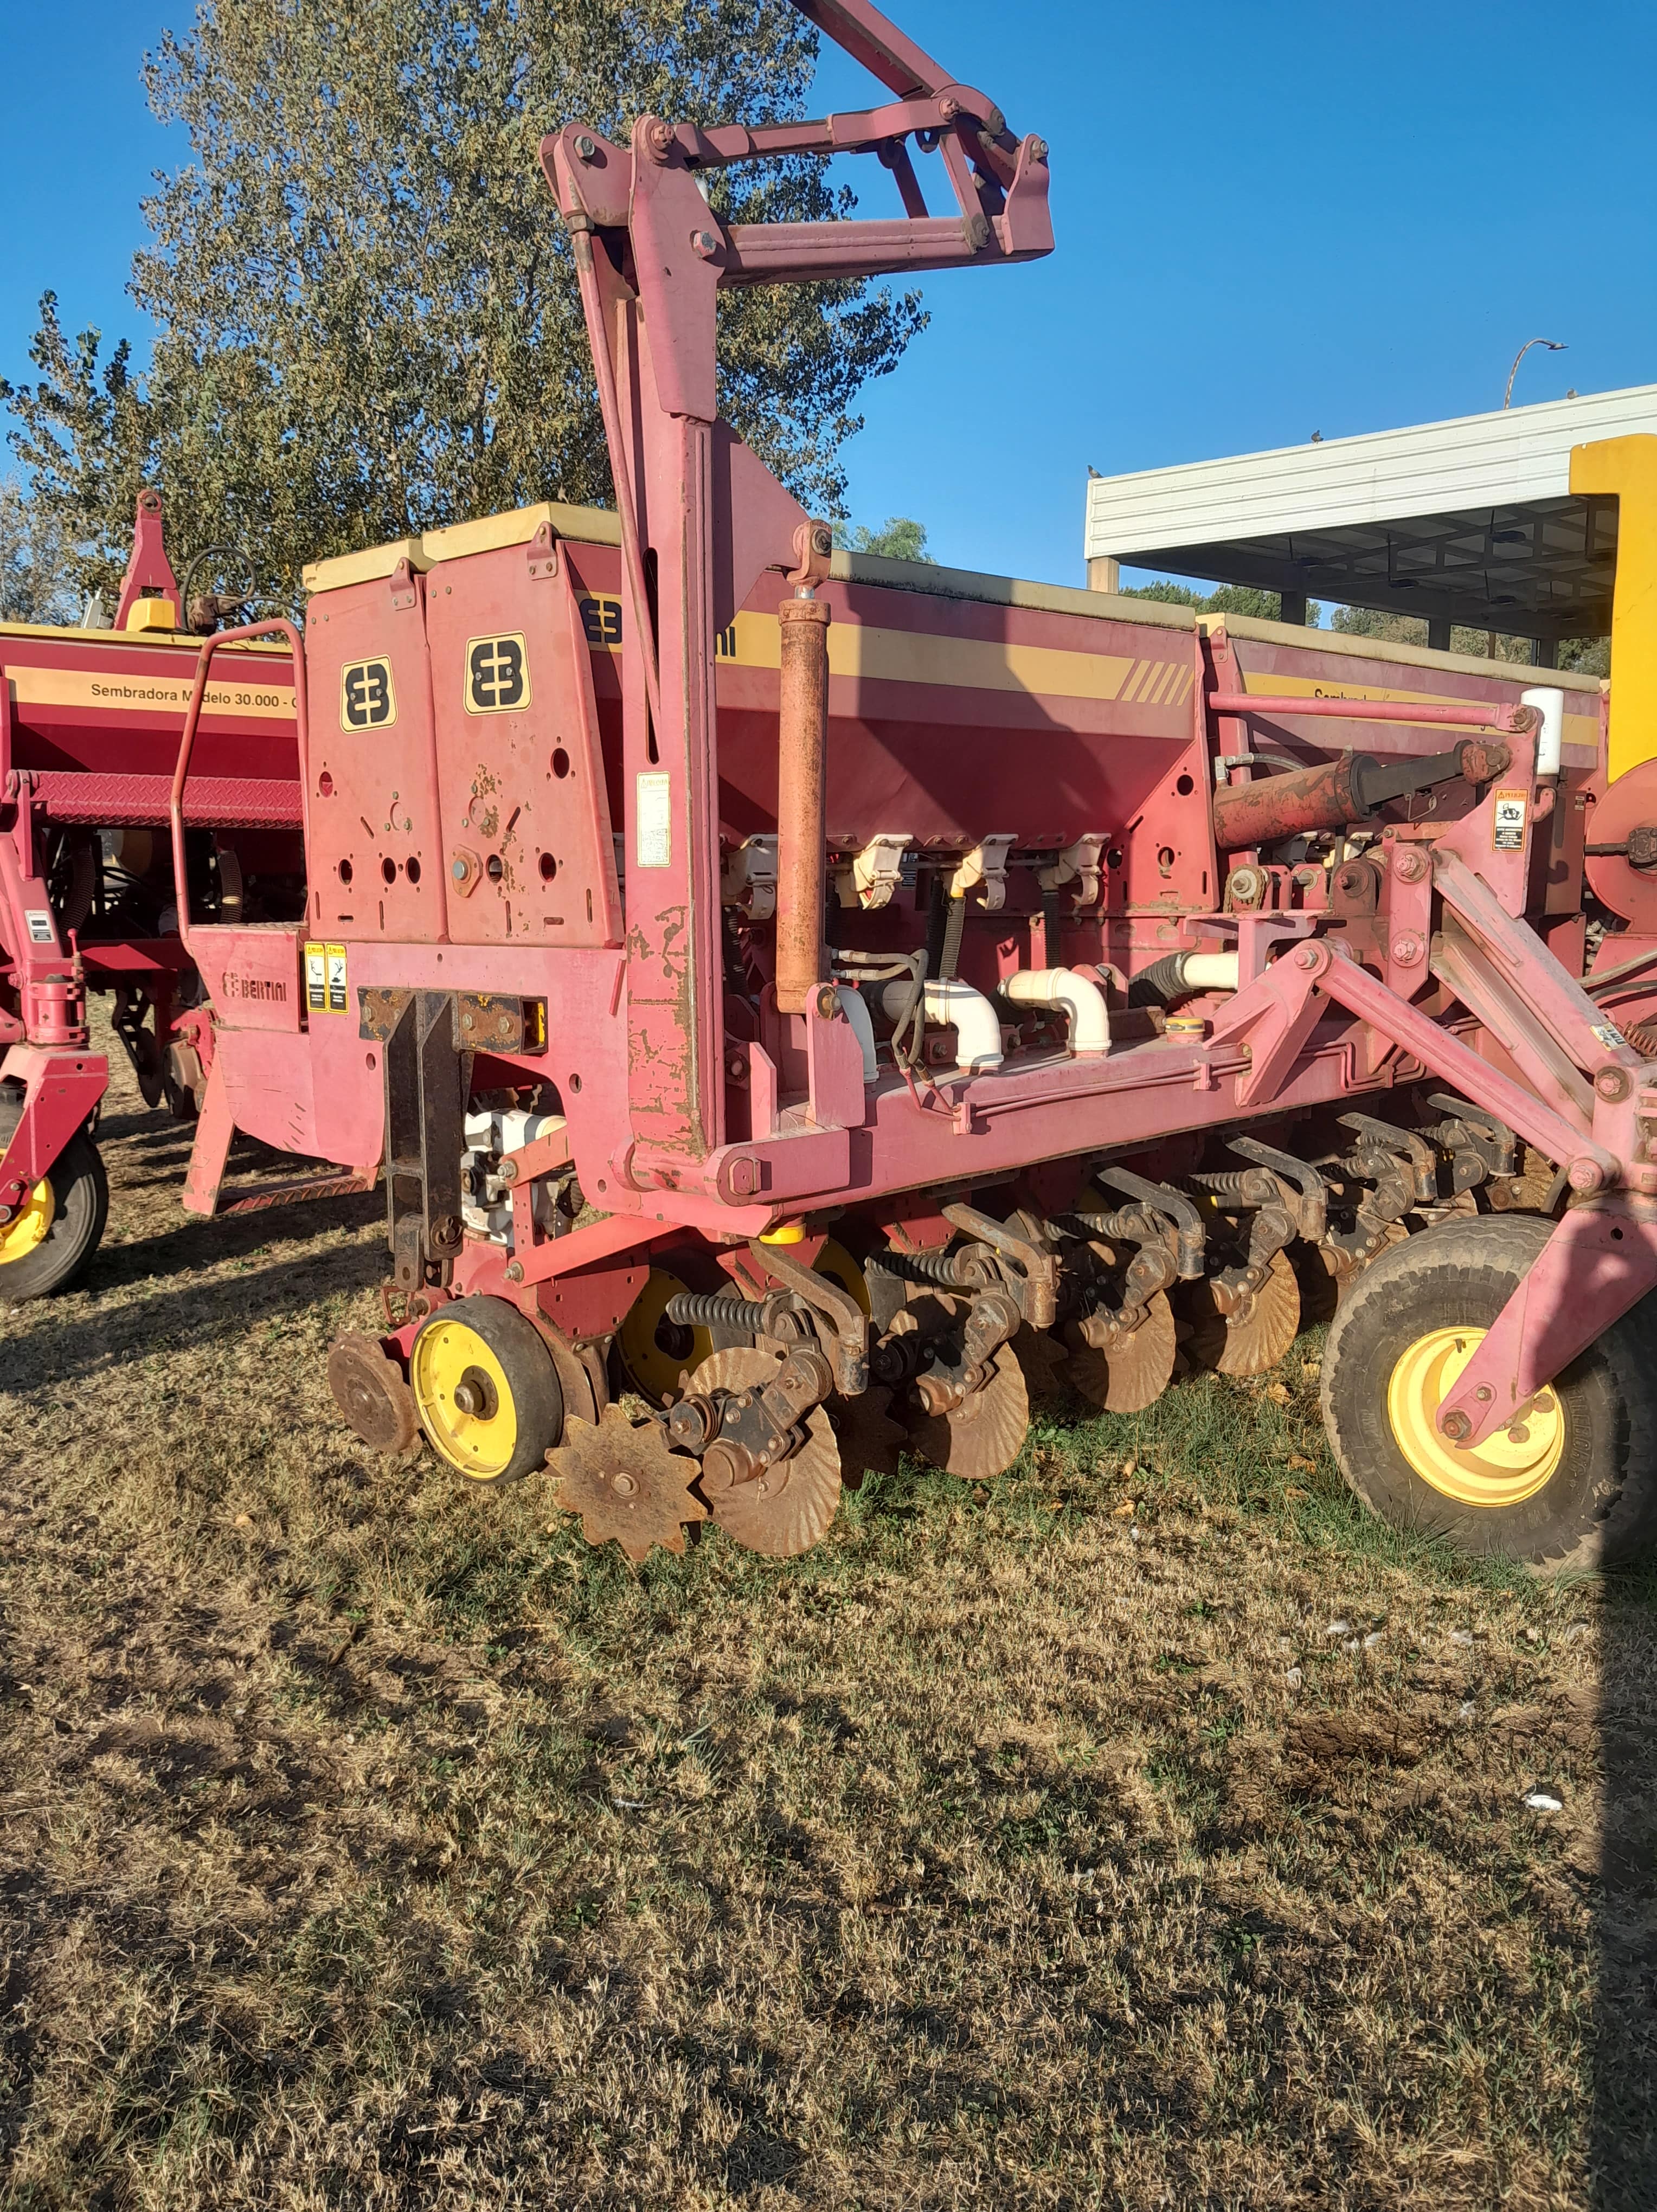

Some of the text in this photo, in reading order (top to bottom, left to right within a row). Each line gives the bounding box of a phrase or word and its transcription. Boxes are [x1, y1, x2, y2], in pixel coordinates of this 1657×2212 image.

[91, 683, 178, 701] Sembradora
[182, 689, 231, 704] Mdelo
[235, 693, 279, 707] 30.000
